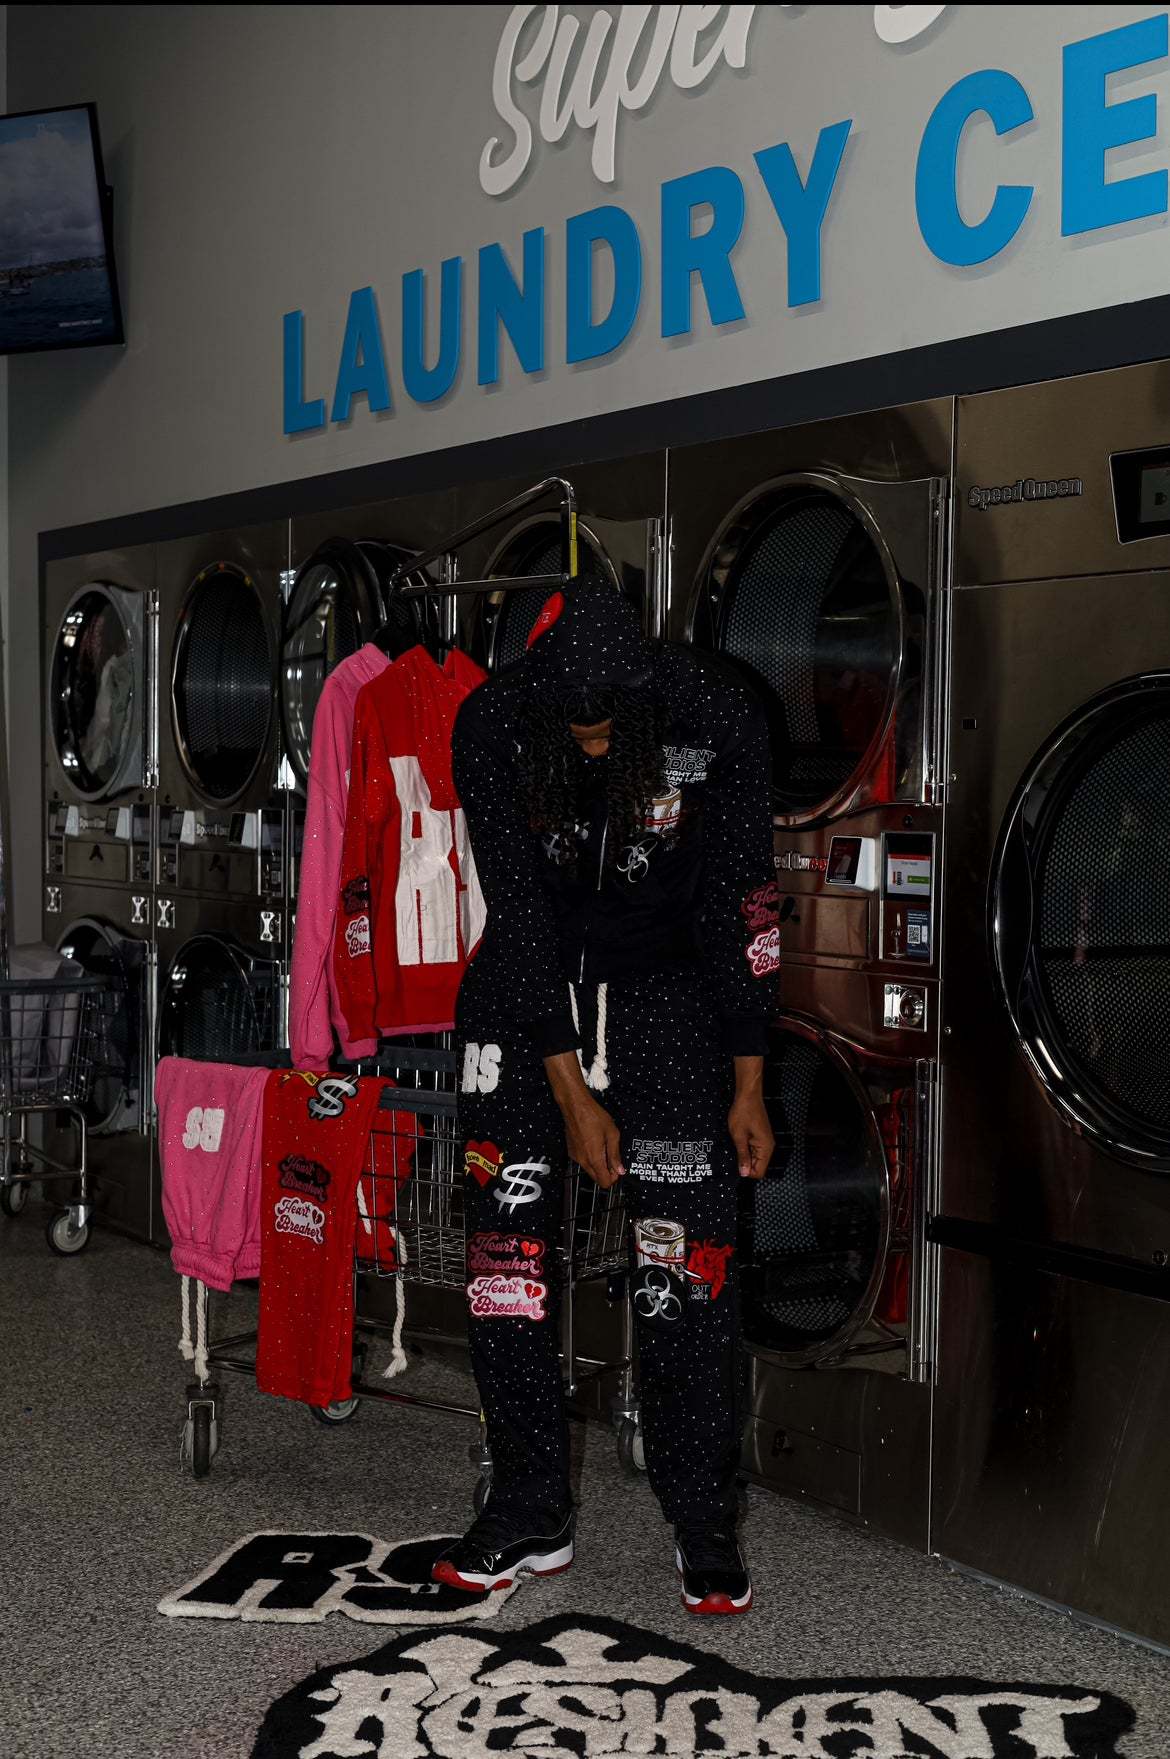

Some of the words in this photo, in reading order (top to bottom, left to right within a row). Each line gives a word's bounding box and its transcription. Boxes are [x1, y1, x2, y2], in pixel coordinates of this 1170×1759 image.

[283, 119, 852, 434] LAUNDRY
[915, 13, 1169, 267] CE
[968, 480, 1024, 511] Speed
[1023, 478, 1084, 501] Queen
[662, 744, 716, 763] ILIENT
[664, 769, 692, 777] UGHT
[632, 1138, 713, 1153] RESILIENT
[631, 1162, 653, 1170] PAIN
[636, 1152, 708, 1164] STUDIOS
[661, 1169, 686, 1177] THAN
[689, 1169, 712, 1177] LOVE
[278, 1199, 310, 1218] Heart
[277, 1213, 323, 1243] Breaker
[469, 1234, 519, 1253] Heart
[470, 1252, 540, 1275] Breaker
[471, 1276, 520, 1297] Heart
[473, 1295, 543, 1318] Breaker
